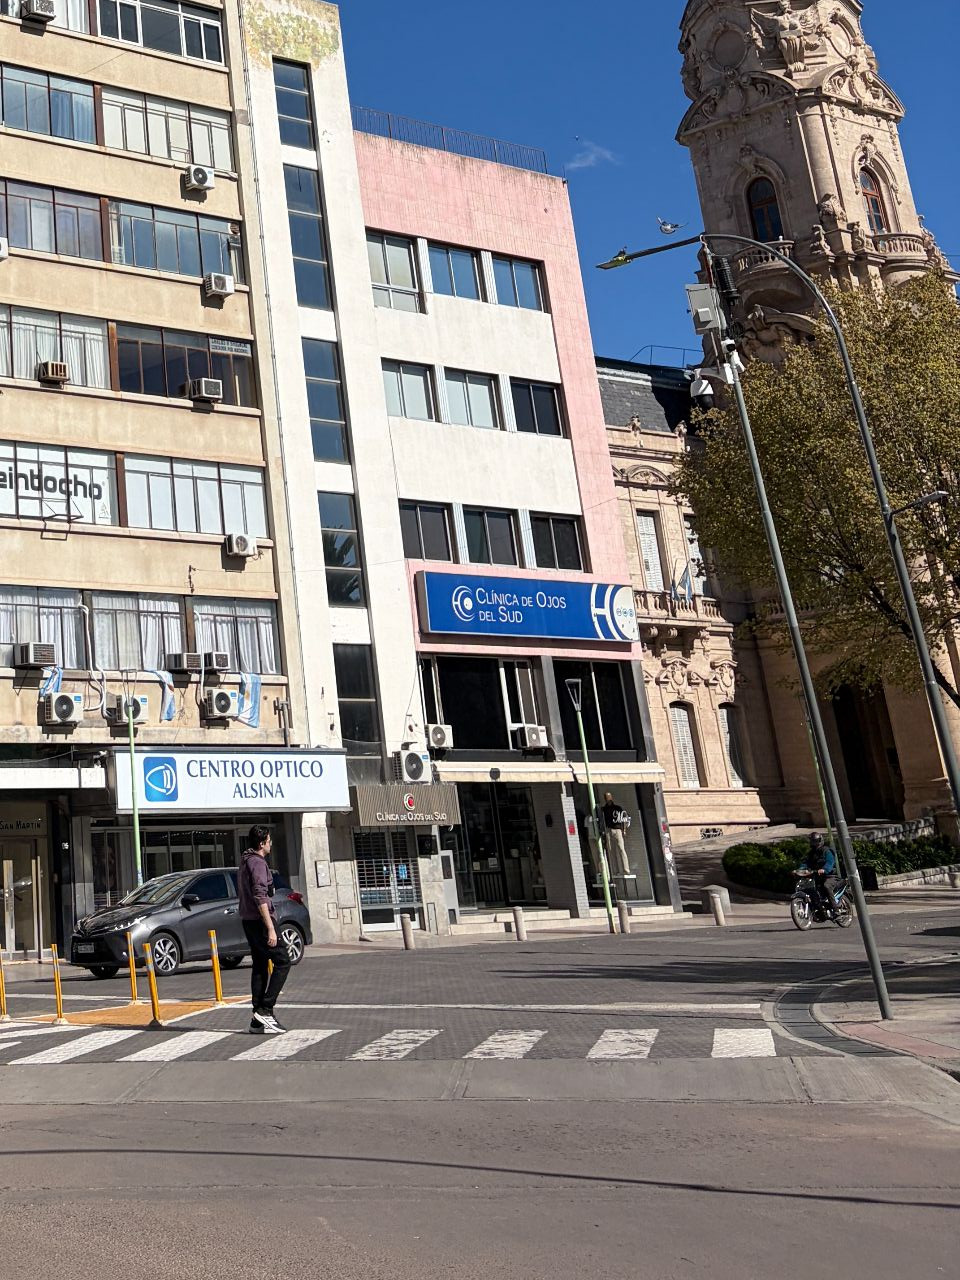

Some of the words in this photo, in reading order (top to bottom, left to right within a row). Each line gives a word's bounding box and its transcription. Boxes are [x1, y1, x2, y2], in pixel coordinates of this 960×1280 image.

[476, 588, 519, 606] CLÍNICA
[521, 597, 533, 607] DE
[536, 591, 567, 609] OJOS
[479, 611, 496, 621] DEL
[499, 606, 523, 623] SUD
[186, 759, 255, 778] CENTRO
[260, 760, 324, 778] OPTICO
[232, 782, 285, 799] ALSINA
[434, 811, 447, 820] SUD
